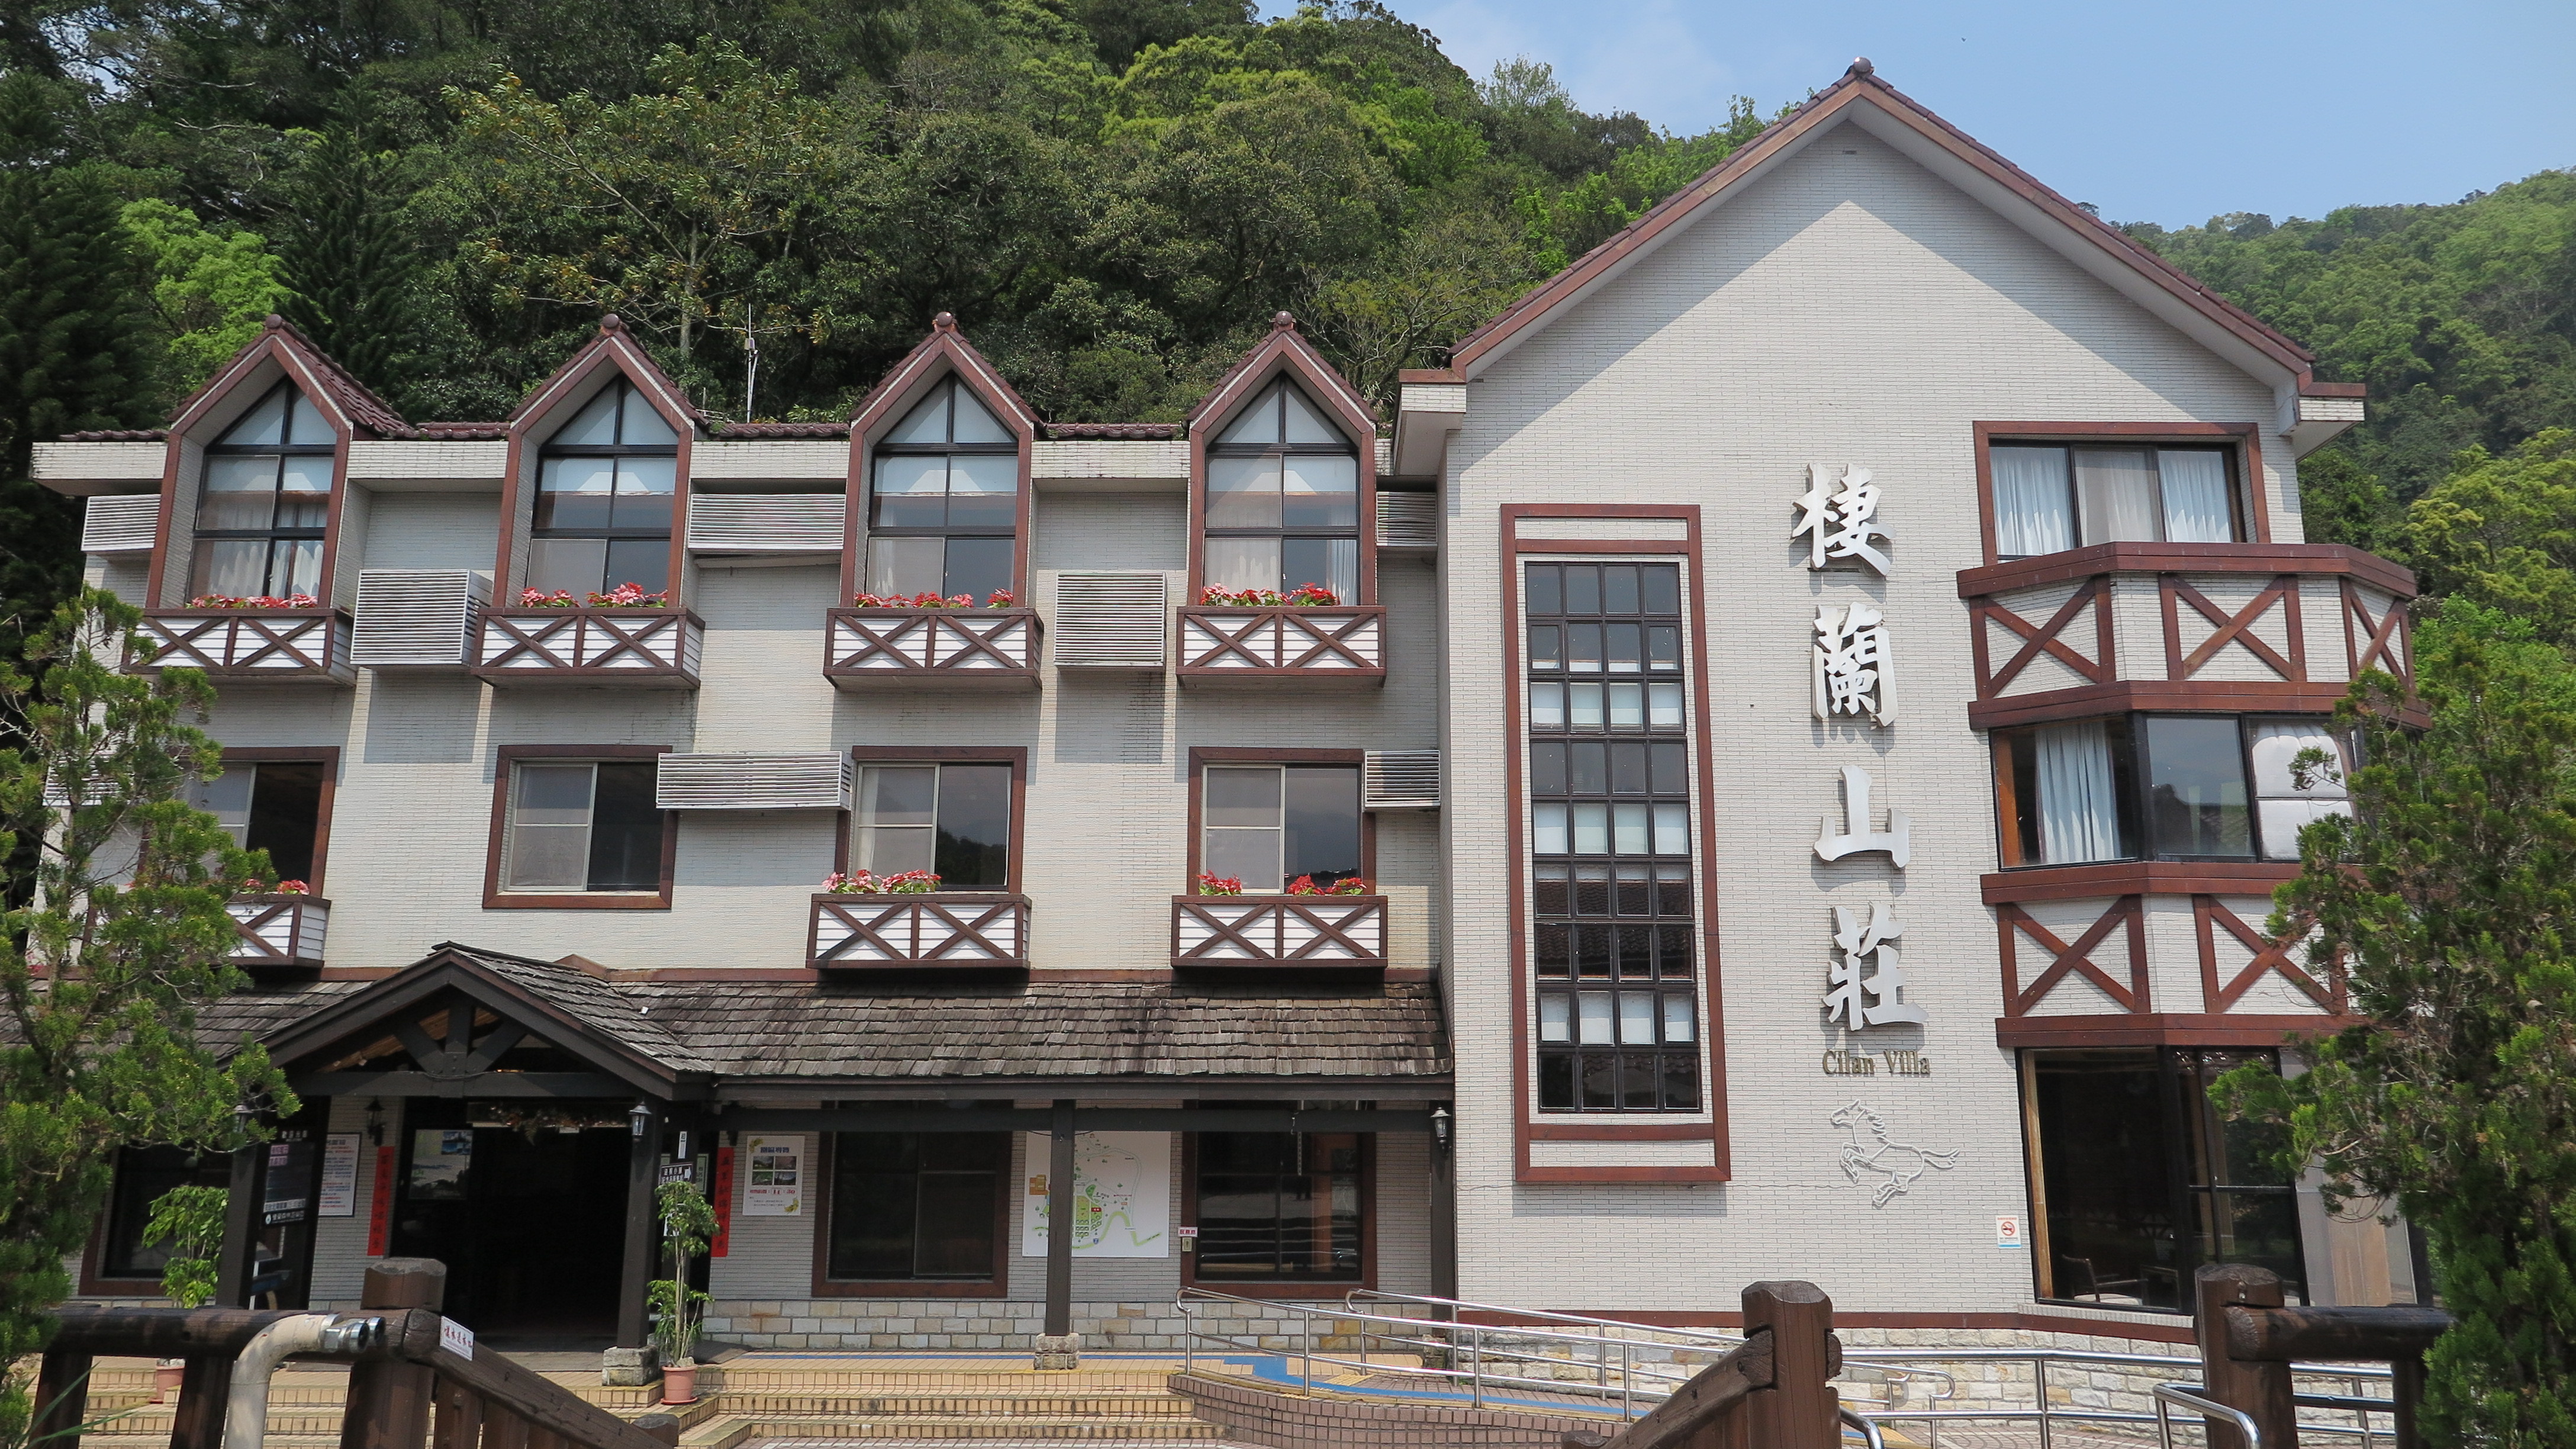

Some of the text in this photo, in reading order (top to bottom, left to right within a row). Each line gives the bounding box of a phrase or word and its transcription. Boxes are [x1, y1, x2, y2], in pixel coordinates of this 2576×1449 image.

[1792, 462, 1929, 1032] 棲蘭山莊
[1822, 1049, 1931, 1074] Cilan Villa
